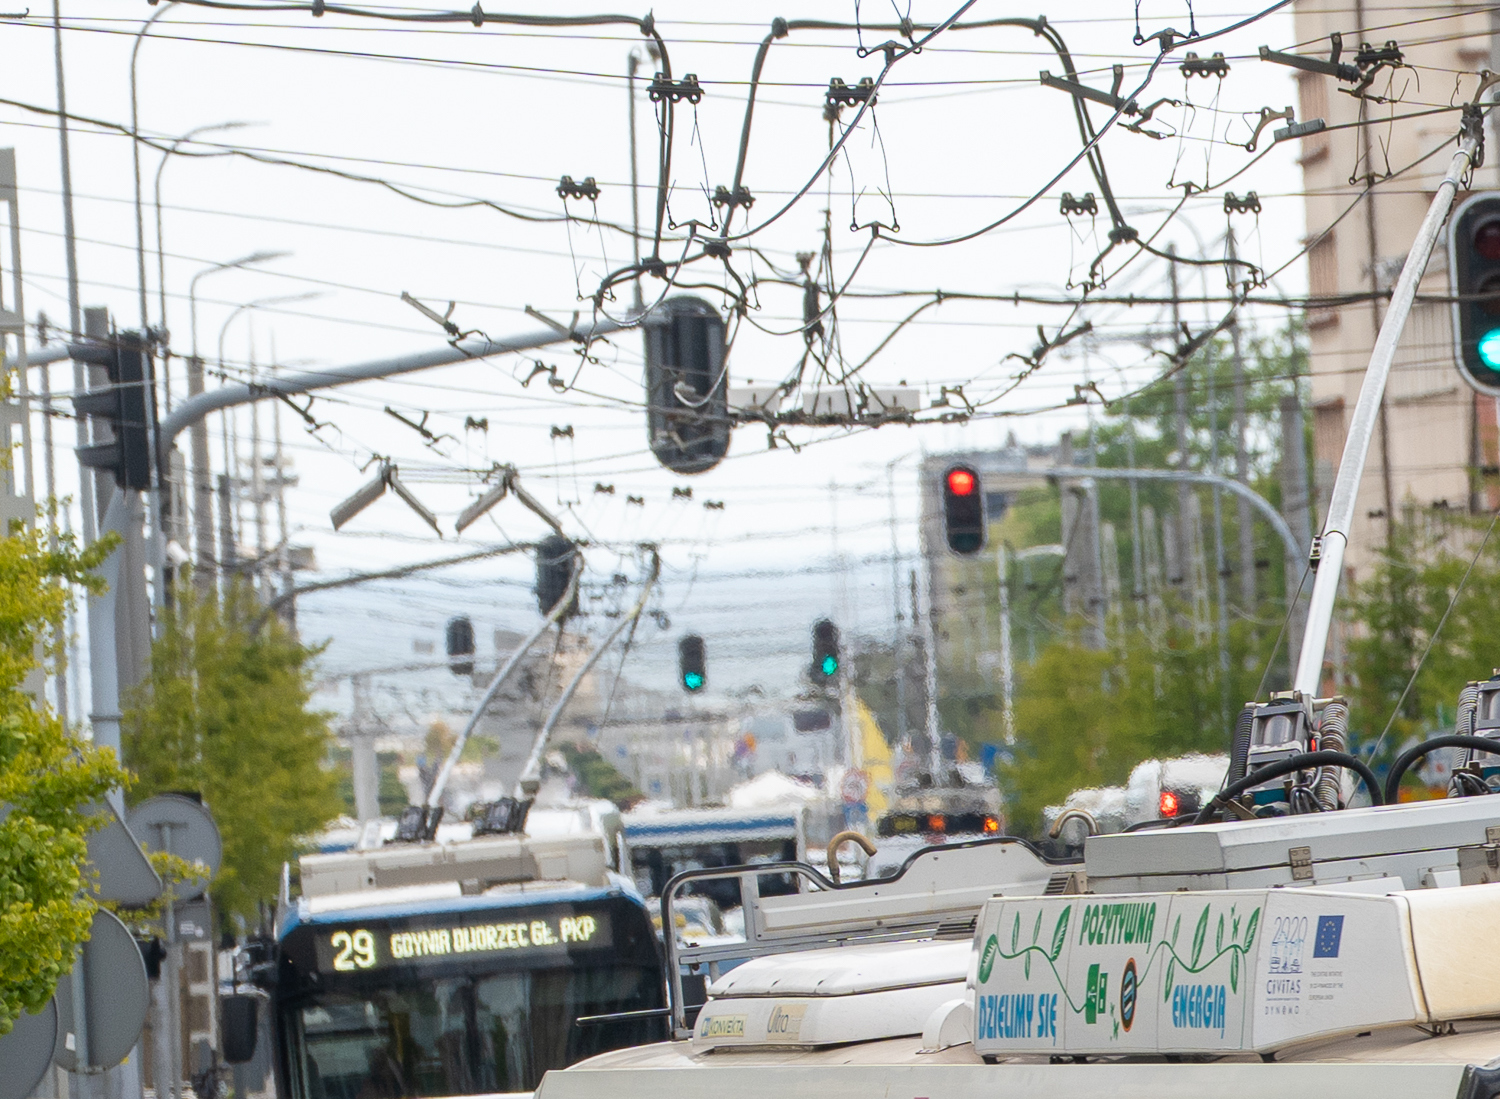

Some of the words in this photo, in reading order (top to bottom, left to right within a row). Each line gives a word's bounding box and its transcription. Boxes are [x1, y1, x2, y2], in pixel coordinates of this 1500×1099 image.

[331, 928, 377, 971] 29
[390, 927, 451, 958] GDYNIA
[452, 922, 530, 952] DWORZEC
[558, 915, 597, 943] PKP
[1079, 902, 1157, 954] POZYTYWNĄ
[979, 993, 1035, 1039] DZIELIMY
[1037, 993, 1058, 1046] SIĘ
[1172, 984, 1226, 1039] ENERGIĄ
